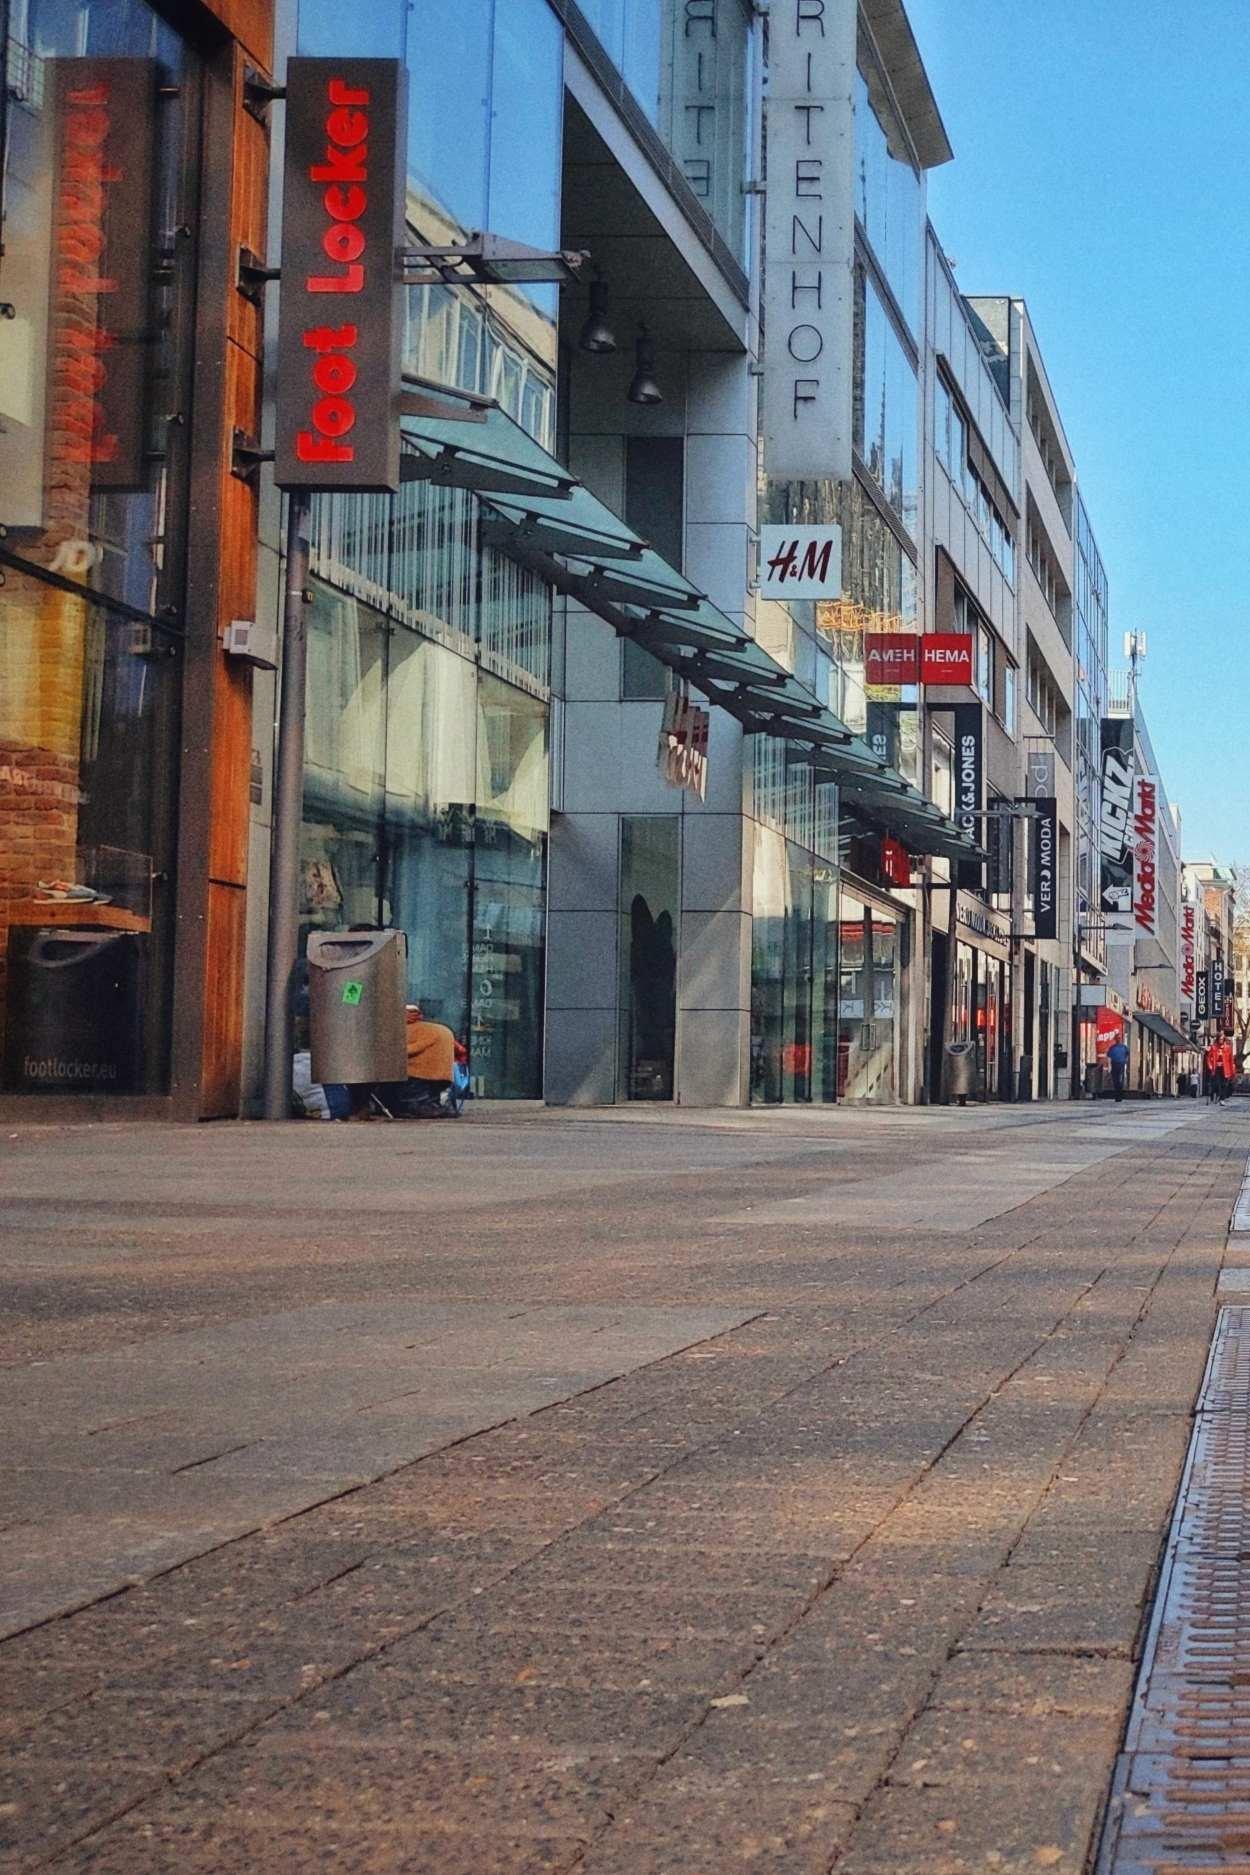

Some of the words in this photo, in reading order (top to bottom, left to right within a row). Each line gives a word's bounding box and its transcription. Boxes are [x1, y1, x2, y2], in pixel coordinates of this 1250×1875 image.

[306, 76, 370, 293] Locker
[297, 322, 357, 463] Foot
[768, 540, 833, 583] H&M
[924, 650, 969, 662] HEMA
[961, 735, 975, 839] ACK&JONES
[1101, 753, 1134, 861] KICKZ
[1133, 778, 1158, 843] Markt
[1040, 817, 1052, 866] MODA
[1133, 863, 1157, 936] Media
[1180, 904, 1196, 946] Markt
[1198, 976, 1206, 1014] GEOX
[1214, 962, 1223, 1011] HOTEL
